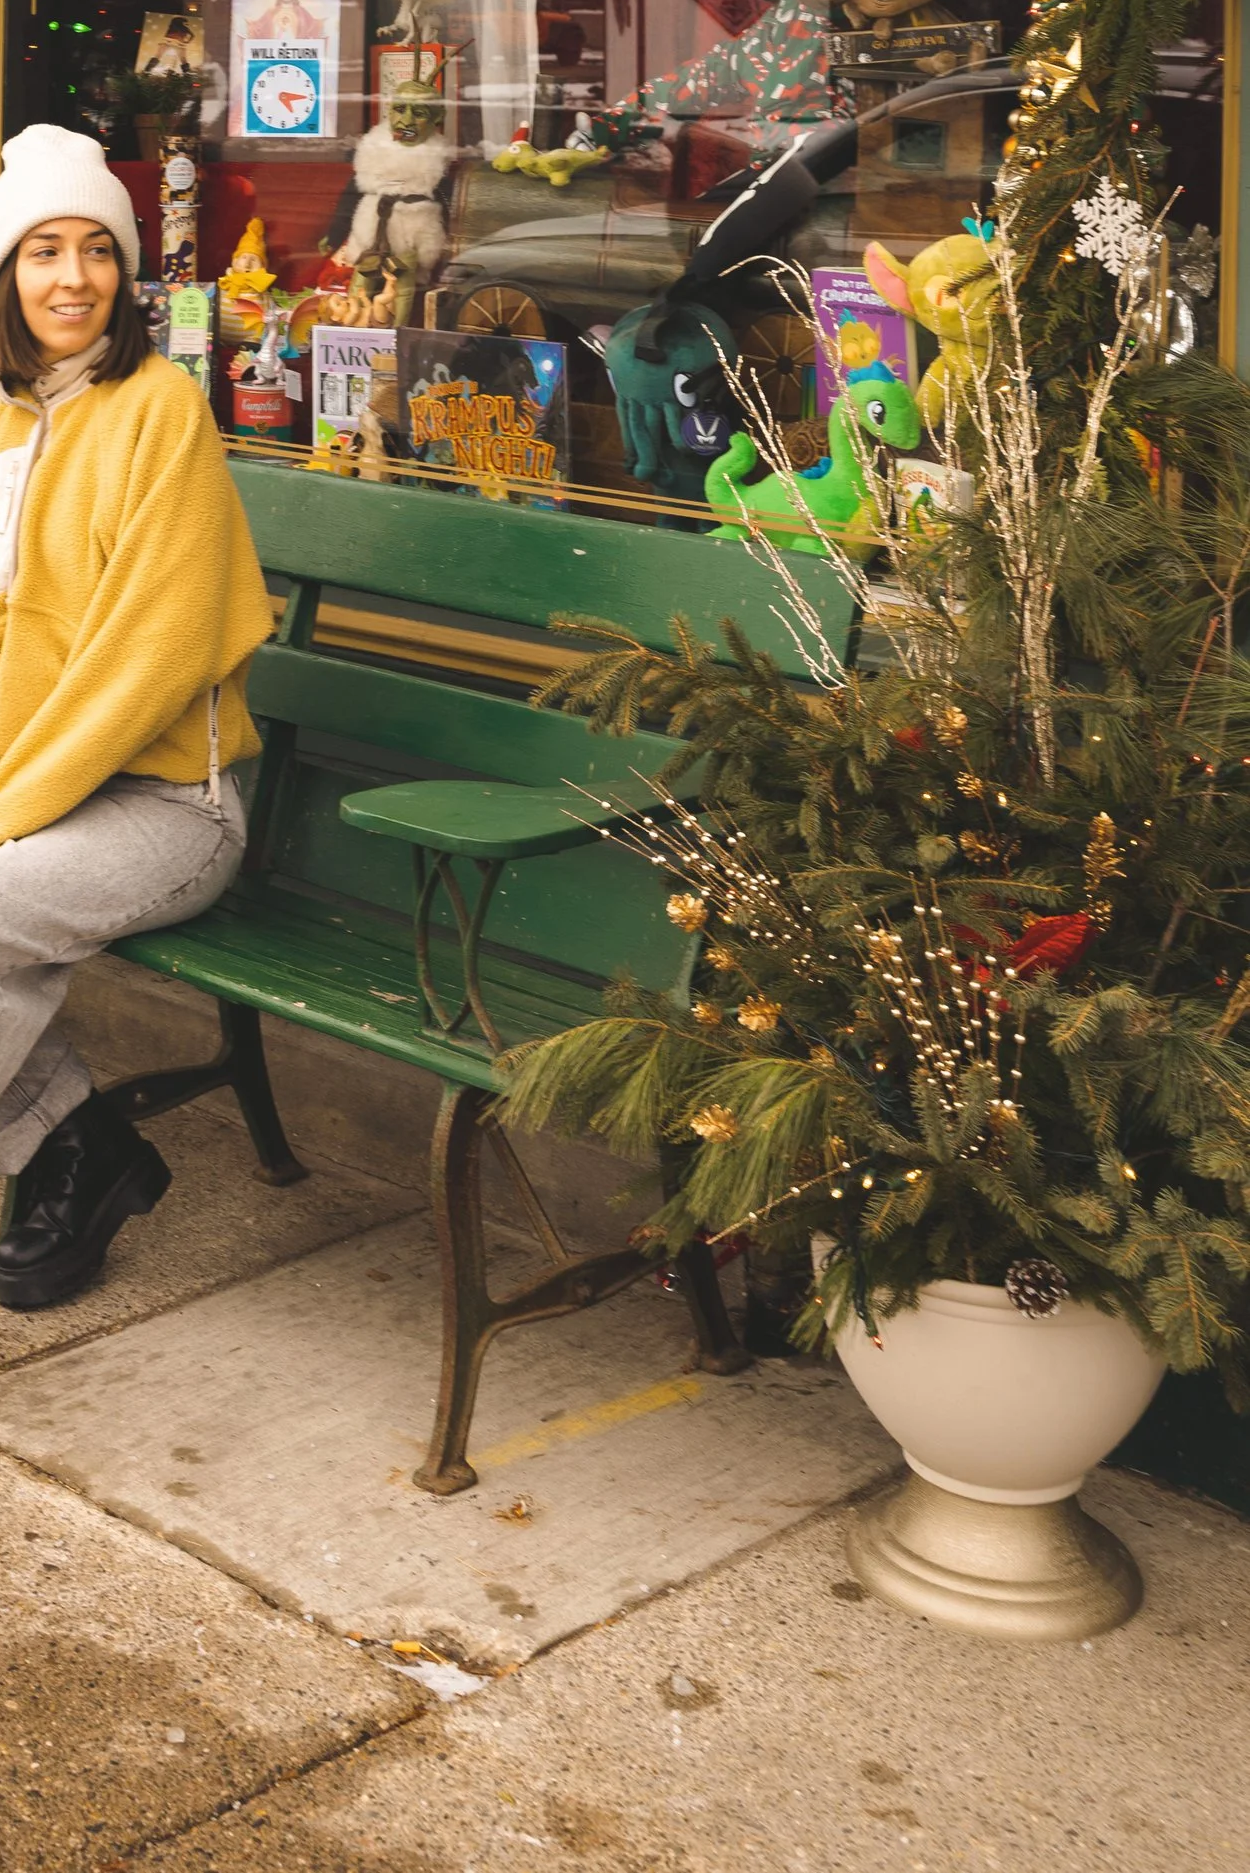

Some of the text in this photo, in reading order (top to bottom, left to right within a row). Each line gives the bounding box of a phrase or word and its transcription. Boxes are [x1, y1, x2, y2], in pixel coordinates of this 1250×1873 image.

[871, 40, 889, 50] GO
[923, 36, 947, 46] EVIL
[251, 48, 318, 59] WILL RETURN
[408, 393, 536, 446] KRAMPUS
